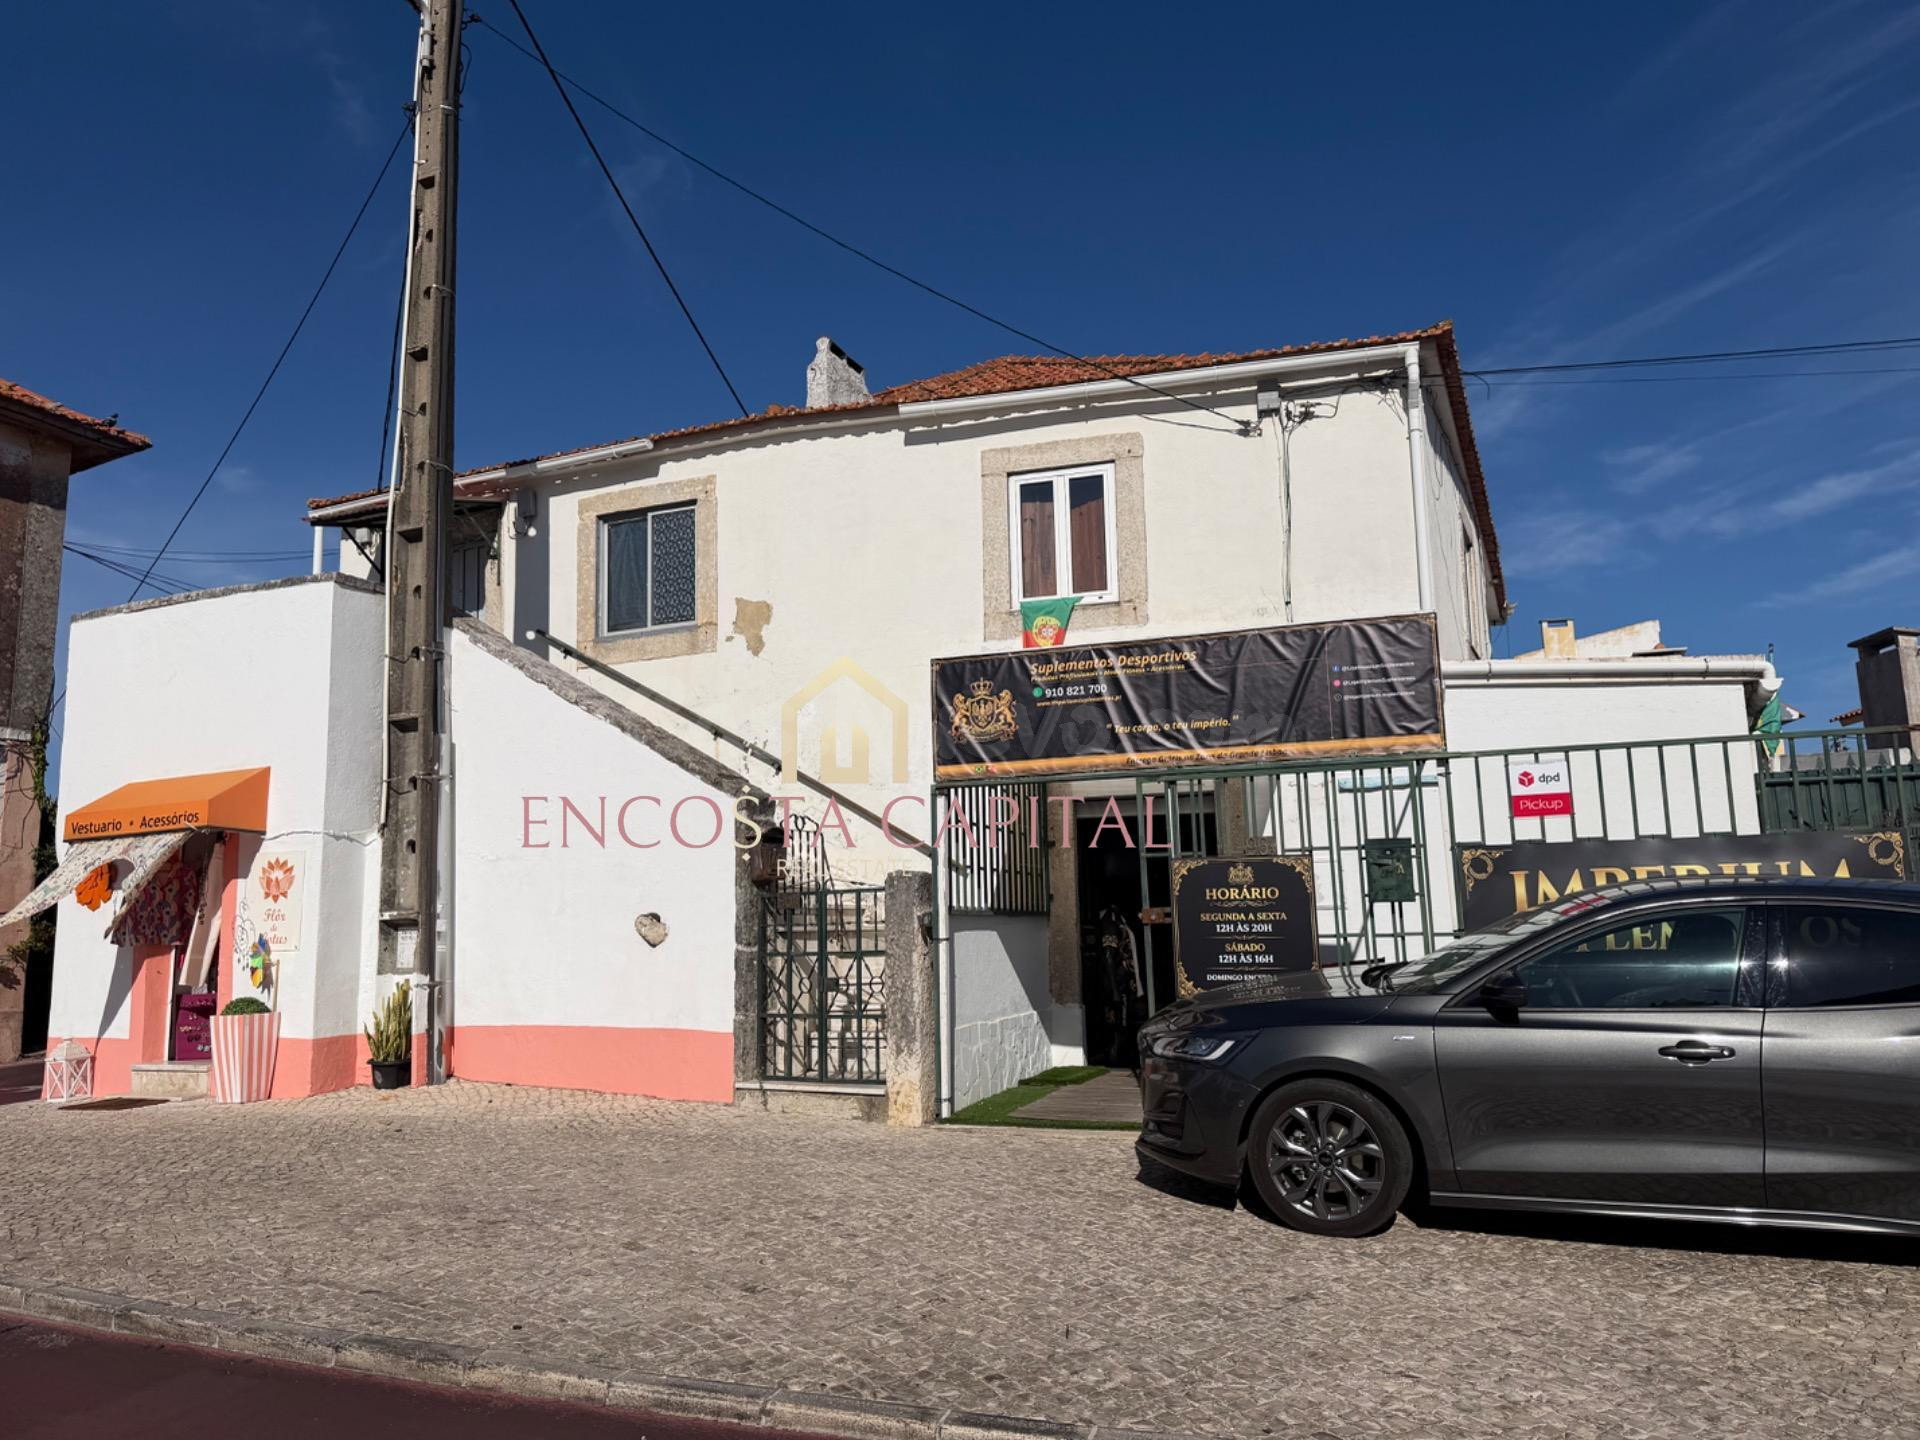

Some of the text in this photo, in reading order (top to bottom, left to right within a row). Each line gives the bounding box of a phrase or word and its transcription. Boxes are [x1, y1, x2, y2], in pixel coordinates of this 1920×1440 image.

[1031, 650, 1197, 676] Suplementos Desportivos
[1045, 684, 1107, 698] 910 821 700
[1538, 772, 1560, 784] dpd
[71, 811, 200, 834] Vestuario Acessórios
[1205, 885, 1280, 900] HORÁRIO
[1200, 912, 1287, 922] SEGUNDA A SEXTA
[1216, 922, 1272, 932] 12H ÀS 20H
[1225, 942, 1266, 952] SÁBADO
[1218, 953, 1274, 963] 12H ÀS 16H
